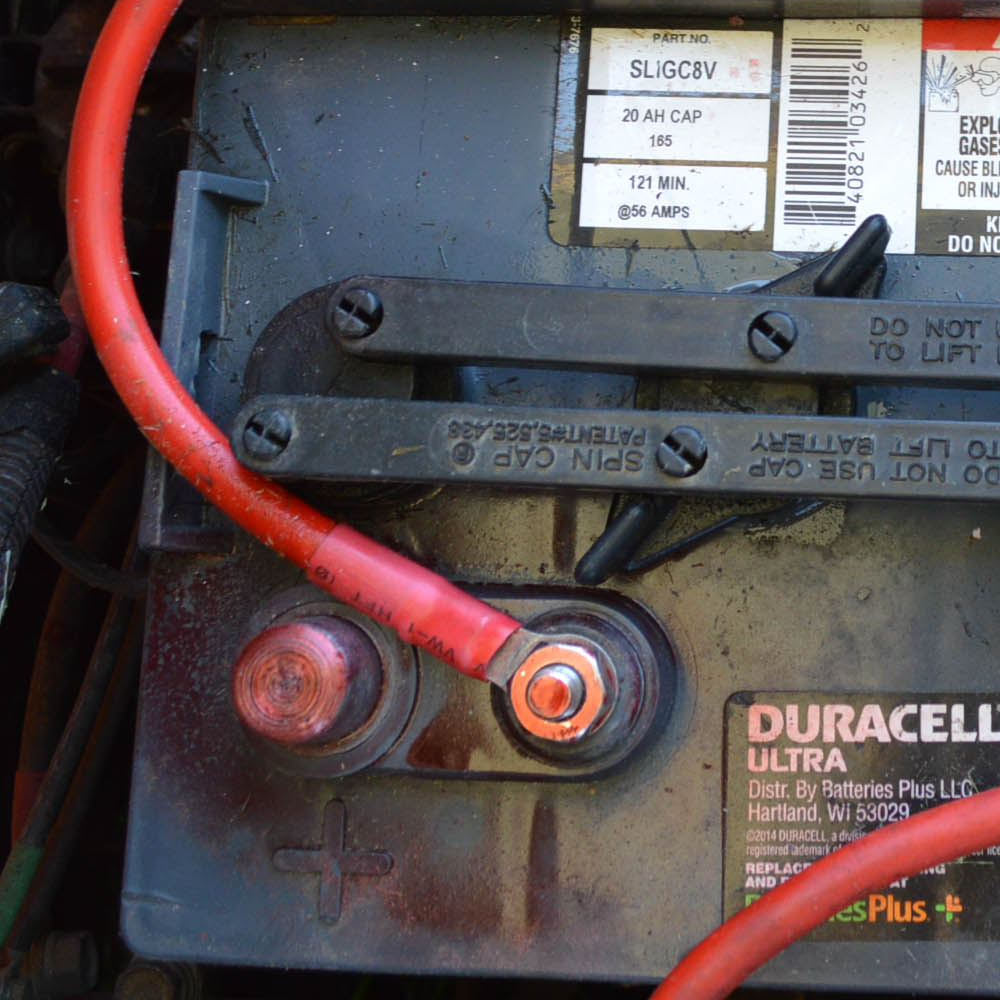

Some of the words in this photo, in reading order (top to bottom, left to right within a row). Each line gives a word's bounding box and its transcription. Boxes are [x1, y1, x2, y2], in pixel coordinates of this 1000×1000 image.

[856, 23, 870, 32] 2
[630, 59, 718, 80] SLIGC8V
[849, 61, 868, 127] 03426
[622, 109, 639, 123] 20
[642, 109, 665, 123] AH
[670, 110, 703, 124] CAP
[649, 134, 673, 147] 165
[847, 140, 865, 203] 40821
[935, 160, 978, 176] CAUSE
[629, 175, 652, 190] 121
[657, 176, 690, 190] MIN.
[958, 181, 976, 198] OR
[617, 205, 647, 220] @56
[651, 205, 690, 219] AMPS
[948, 235, 973, 252] DO
[870, 316, 909, 337] DO
[925, 318, 982, 339] NOT
[870, 340, 905, 362] TO
[921, 342, 982, 364] LIFT
[751, 431, 874, 455] BATTERY
[889, 437, 950, 458] LIFT
[493, 446, 555, 469] CAP
[572, 449, 644, 472] SPIN
[749, 457, 803, 478] CAP
[819, 460, 875, 481] USE
[889, 462, 947, 483] NOT
[747, 747, 847, 772] ULTRA
[749, 779, 790, 800] Distr.
[796, 780, 817, 803] By
[822, 779, 894, 800] Batteries
[899, 779, 936, 799] Plus
[748, 802, 822, 824] Hartland,
[856, 803, 910, 822] 53029
[745, 877, 777, 889] AND
